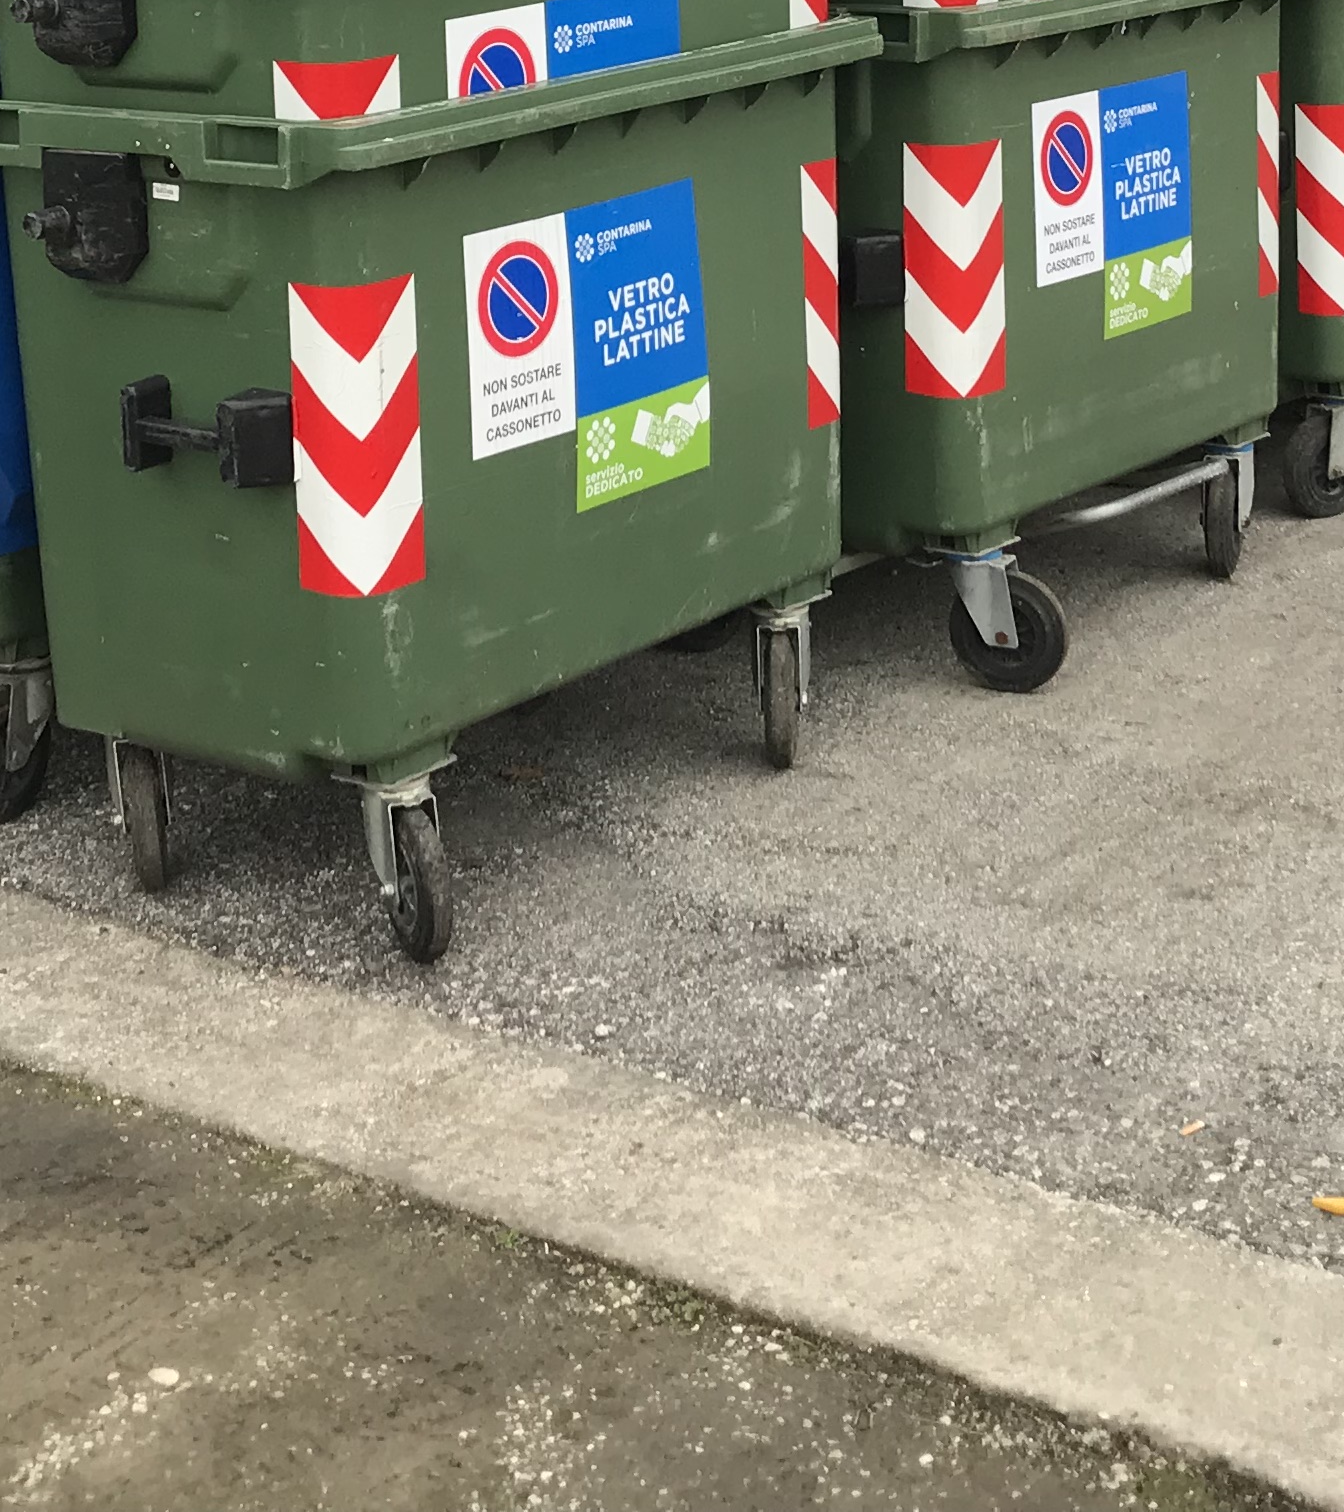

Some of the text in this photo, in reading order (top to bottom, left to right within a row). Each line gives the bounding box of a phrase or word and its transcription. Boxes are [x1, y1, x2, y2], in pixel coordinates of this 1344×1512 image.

[575, 15, 633, 35] CONTARINA
[575, 35, 597, 48] SPA
[1118, 102, 1157, 117] CONTARINA
[1125, 147, 1172, 176] VETRO
[1115, 166, 1182, 201] PLASTICA
[1120, 188, 1177, 221] LATTINE
[596, 219, 652, 243] CONTARINA
[1043, 213, 1096, 237] NON SOSTARE
[597, 241, 618, 257] SPA
[1049, 233, 1092, 255] DAVANTI AL
[1046, 251, 1096, 275] CASSONETTO
[608, 272, 675, 312] VETRO
[594, 293, 691, 344] PLASTICA
[1109, 307, 1149, 329] DEDICATO
[603, 319, 686, 367] LATTINE
[482, 363, 562, 397] NON SOSTARE
[491, 388, 556, 419] DAVANTI AL
[486, 408, 562, 443] CASSONETTO
[585, 461, 625, 484] servizio
[585, 467, 644, 499] DEDICATO
